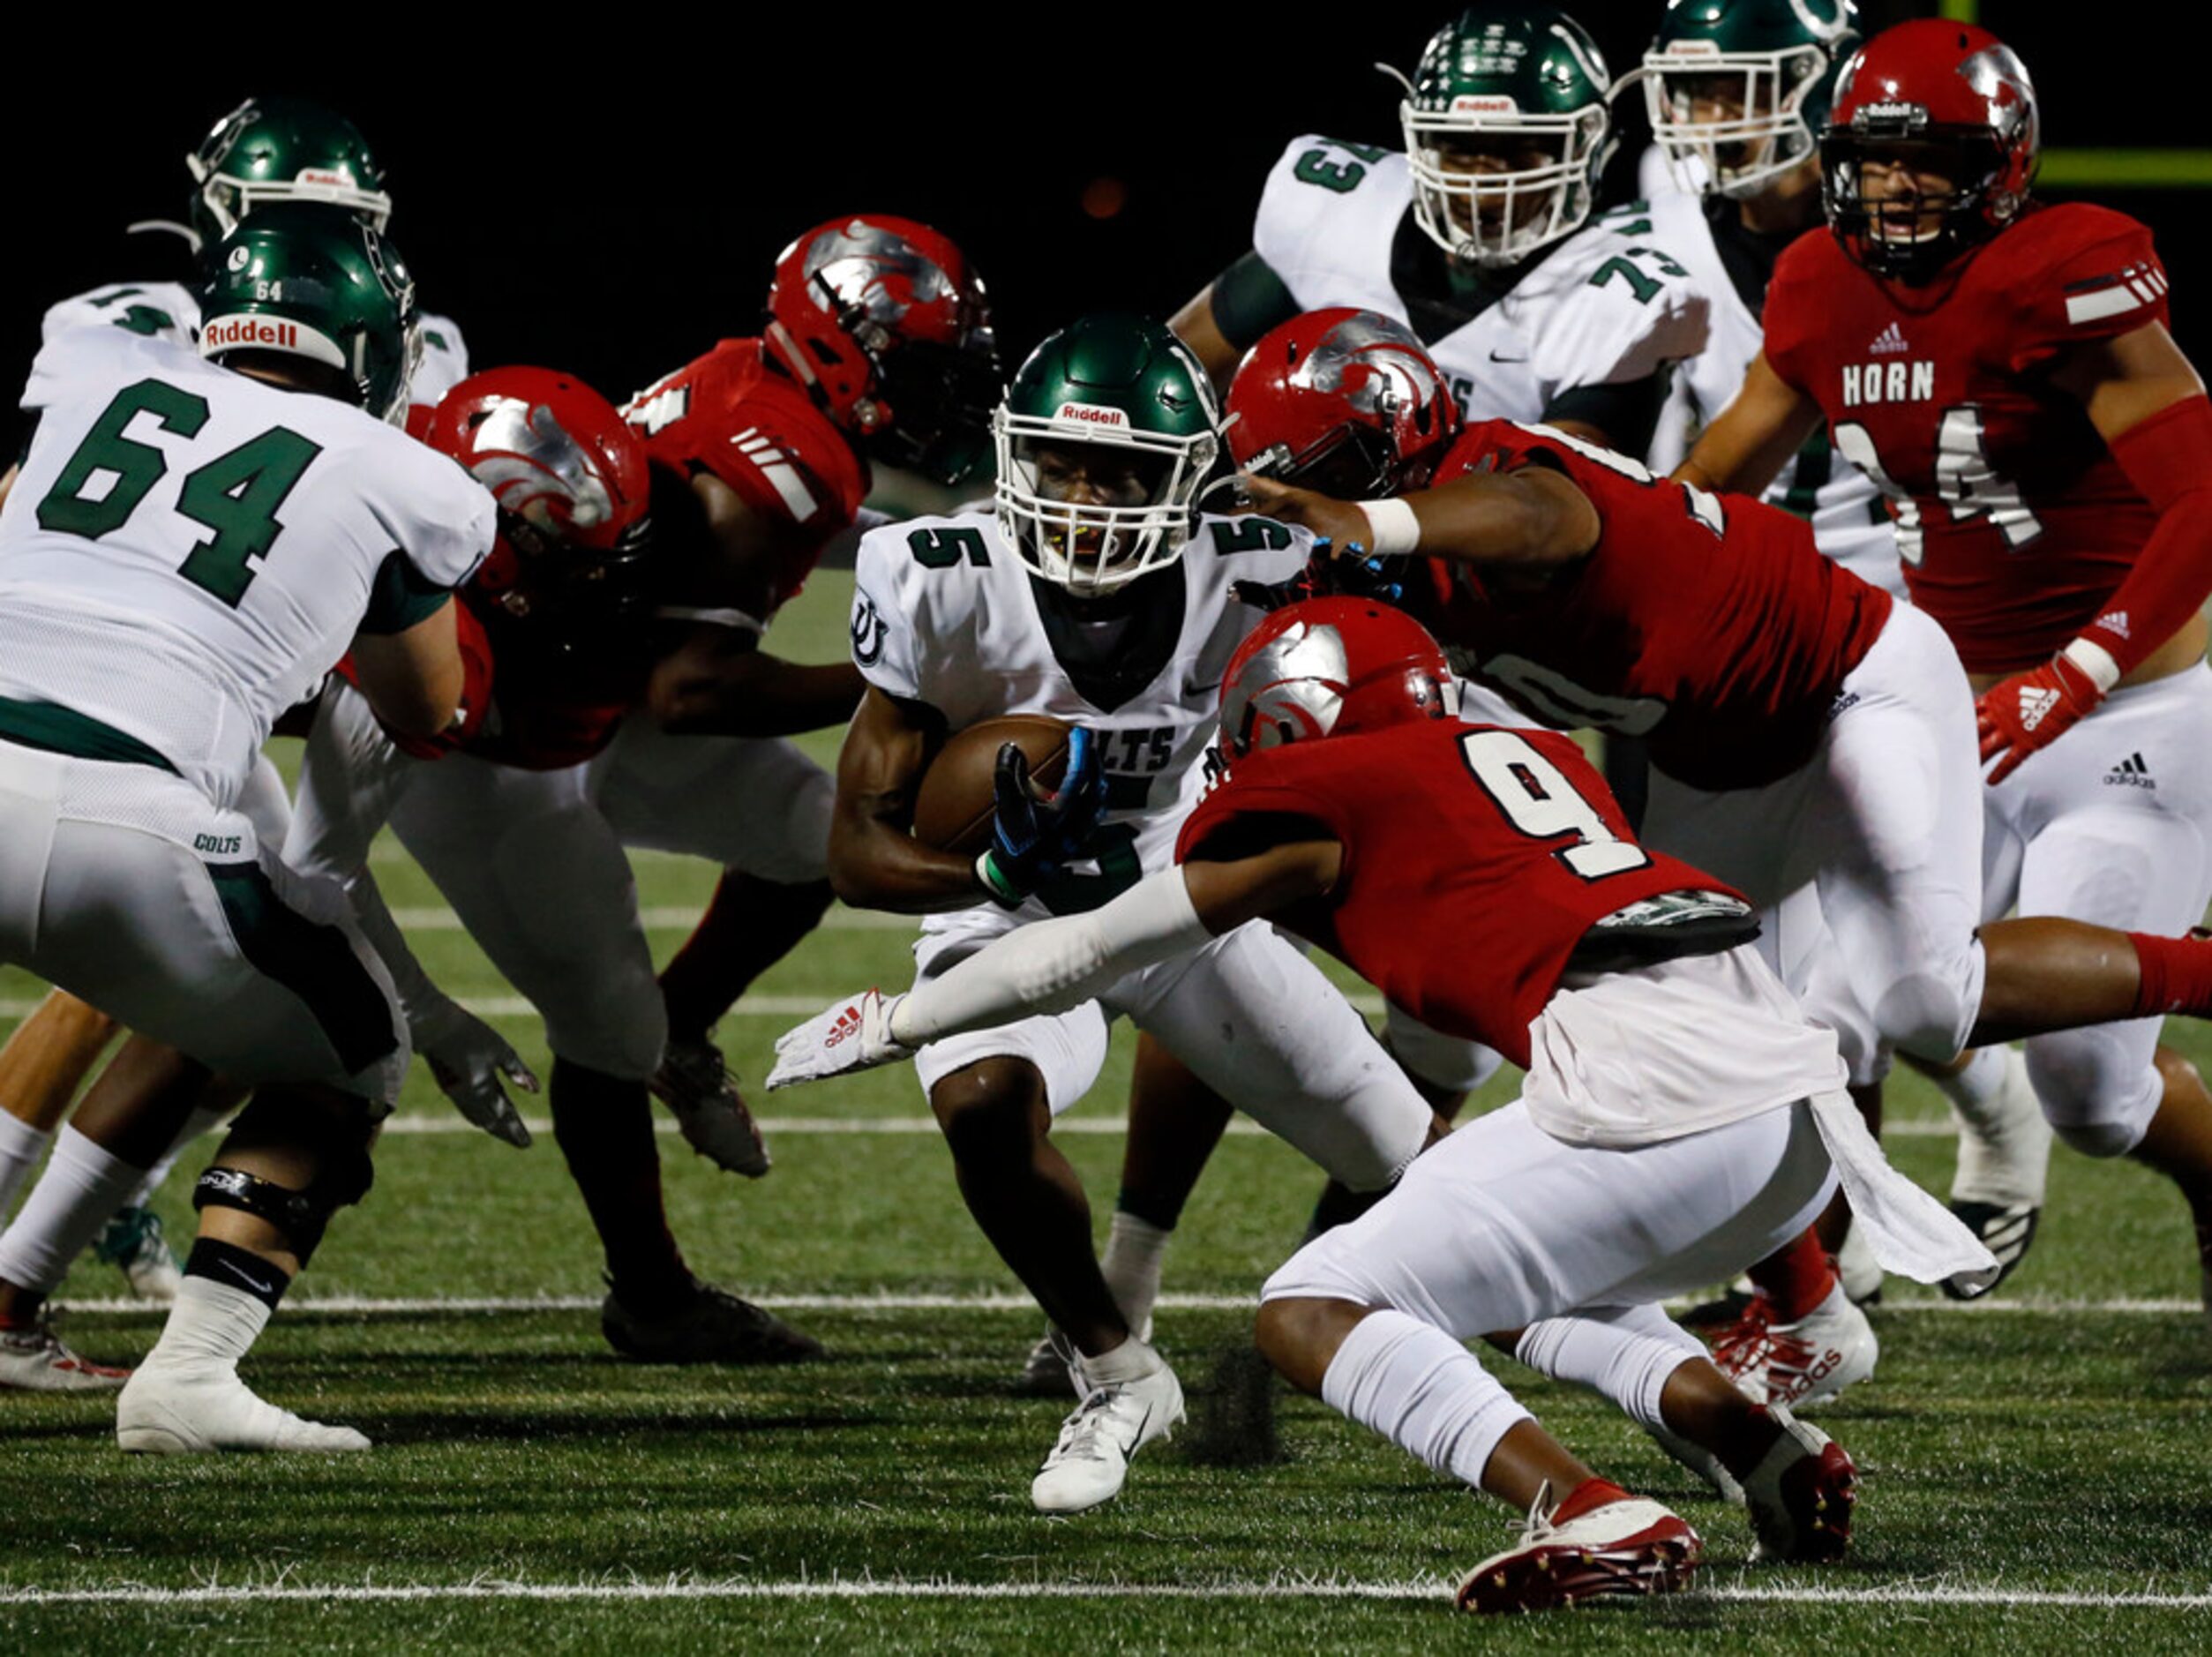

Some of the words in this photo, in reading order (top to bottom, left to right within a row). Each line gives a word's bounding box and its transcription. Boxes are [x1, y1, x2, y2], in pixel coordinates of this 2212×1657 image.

[256, 281, 282, 301] 64
[206, 320, 297, 349] Riddell
[1842, 360, 1935, 407] HORN
[1062, 405, 1121, 425] Riddell
[35, 377, 324, 610] 64
[907, 527, 993, 569] 5
[1210, 516, 1293, 556] 5
[1098, 725, 1176, 772] LTS
[2103, 772, 2156, 790] adidas
[1455, 728, 1654, 883] 9
[193, 833, 242, 854] COLTS
